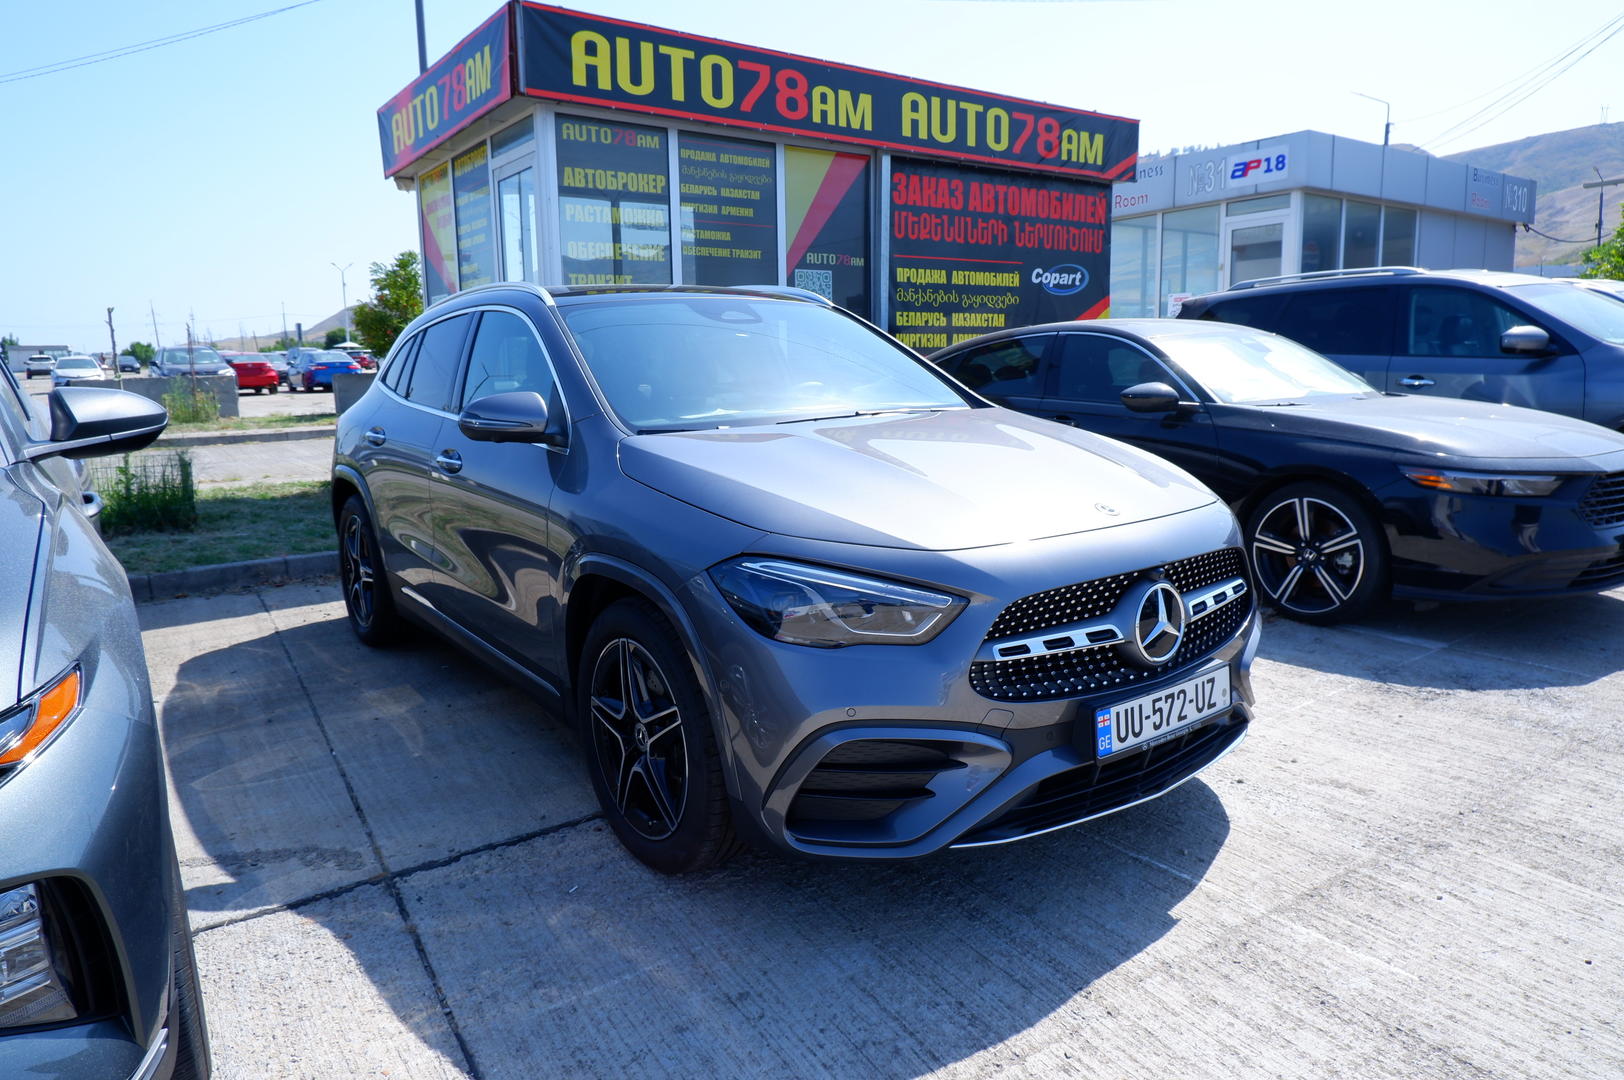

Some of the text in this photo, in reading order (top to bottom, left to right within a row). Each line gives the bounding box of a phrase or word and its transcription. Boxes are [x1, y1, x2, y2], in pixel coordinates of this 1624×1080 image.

[571, 30, 872, 131] AUTO78AM
[391, 44, 491, 155] AUTO78AM
[562, 122, 660, 149] AUTO78AM
[901, 91, 1104, 165] AUTO78AM
[1263, 154, 1286, 174] 18
[563, 166, 666, 193] АВТОБРОКЕР
[680, 183, 717, 196] БЕЛАРУСЬ
[892, 172, 1107, 225] ЗАКАЗ АВТОМОБИЛЕЙ
[1114, 193, 1149, 209] Room
[565, 203, 665, 227] РАСТАМОЖКА
[567, 241, 665, 262] ОБЕСПЕЧЕНИЕ
[806, 252, 865, 267] AUTO78AM
[896, 267, 1020, 287] ПРОДАЖА АВТОМОБИЛЕЙ
[1031, 267, 1082, 288] Copart
[896, 311, 1006, 327] БЕЛАРУСЬ КАЗАХСТАН
[1115, 676, 1217, 744] UU-572-UZ
[1099, 734, 1112, 751] GE
